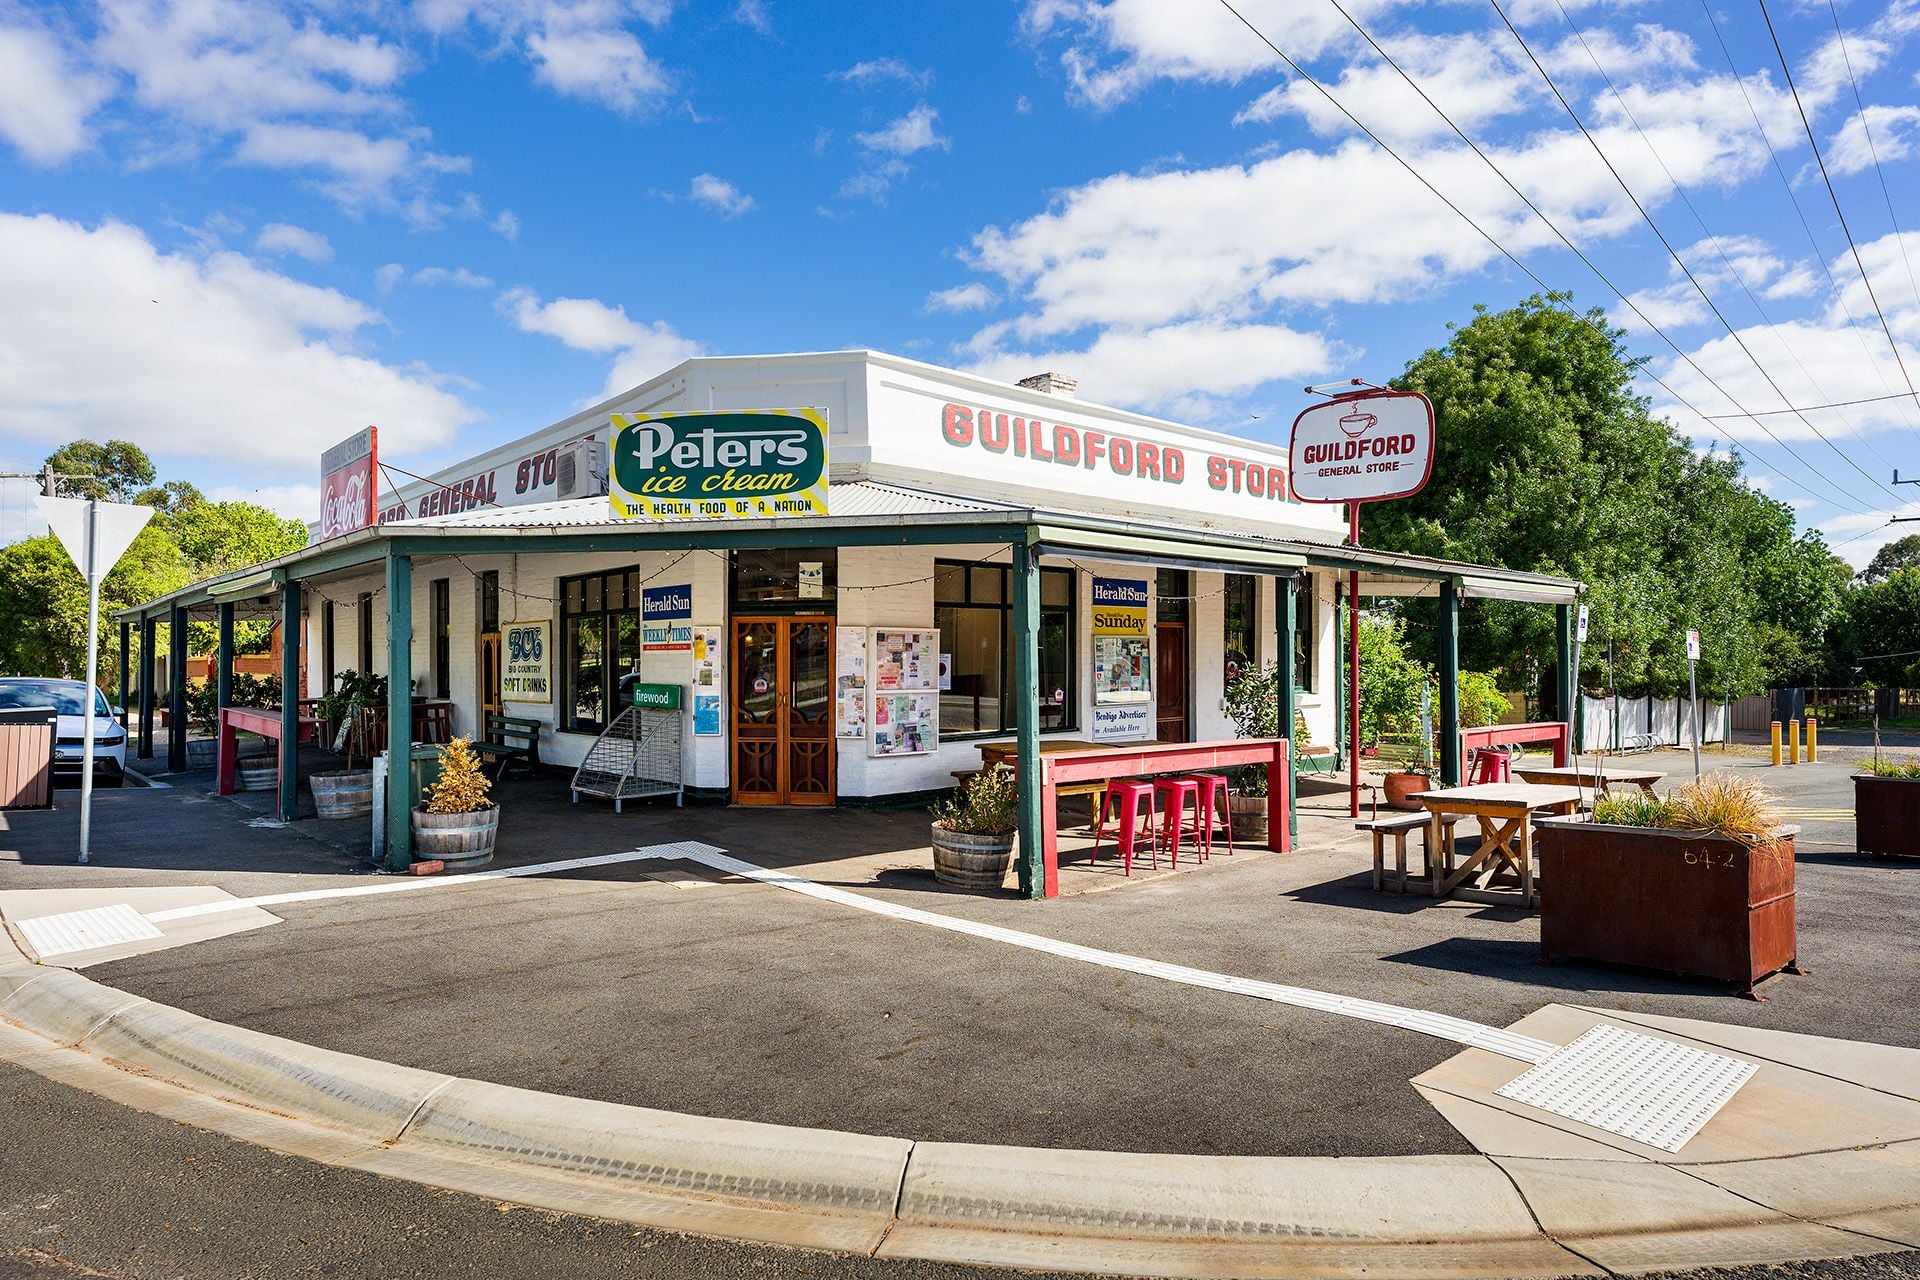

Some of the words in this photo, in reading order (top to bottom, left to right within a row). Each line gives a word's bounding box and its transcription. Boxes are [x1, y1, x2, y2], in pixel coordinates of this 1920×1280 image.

[631, 422, 808, 470] Peters
[942, 402, 1185, 485] GUILDFORD
[1207, 455, 1301, 505] STOR
[1304, 434, 1416, 464] GUILDFORD
[1318, 465, 1362, 478] GENERAL
[1366, 461, 1400, 474] STORE
[641, 466, 687, 493] ice
[701, 469, 799, 492] cream
[419, 471, 497, 519] GENERAL
[626, 504, 645, 515] THE
[653, 503, 691, 514] HEALTH
[699, 502, 726, 514] FOOD
[736, 502, 749, 513] OF
[758, 501, 765, 512] A
[774, 500, 812, 512] NATION
[1094, 584, 1128, 601] Herald
[1128, 588, 1147, 602] Sun
[643, 595, 672, 613] Herald
[672, 594, 690, 610] Sun
[1094, 613, 1146, 633] Sunday
[642, 628, 668, 643] WEEKLY
[671, 626, 692, 642] TIMES
[517, 664, 542, 674] COUNTRY
[503, 677, 520, 692] SOFT
[522, 677, 547, 693] DRINKS
[635, 690, 669, 705] firewood
[1095, 710, 1118, 723] Bendigo
[1118, 710, 1147, 720] Advertiser
[1102, 724, 1127, 734] Available
[1127, 724, 1140, 732] Here
